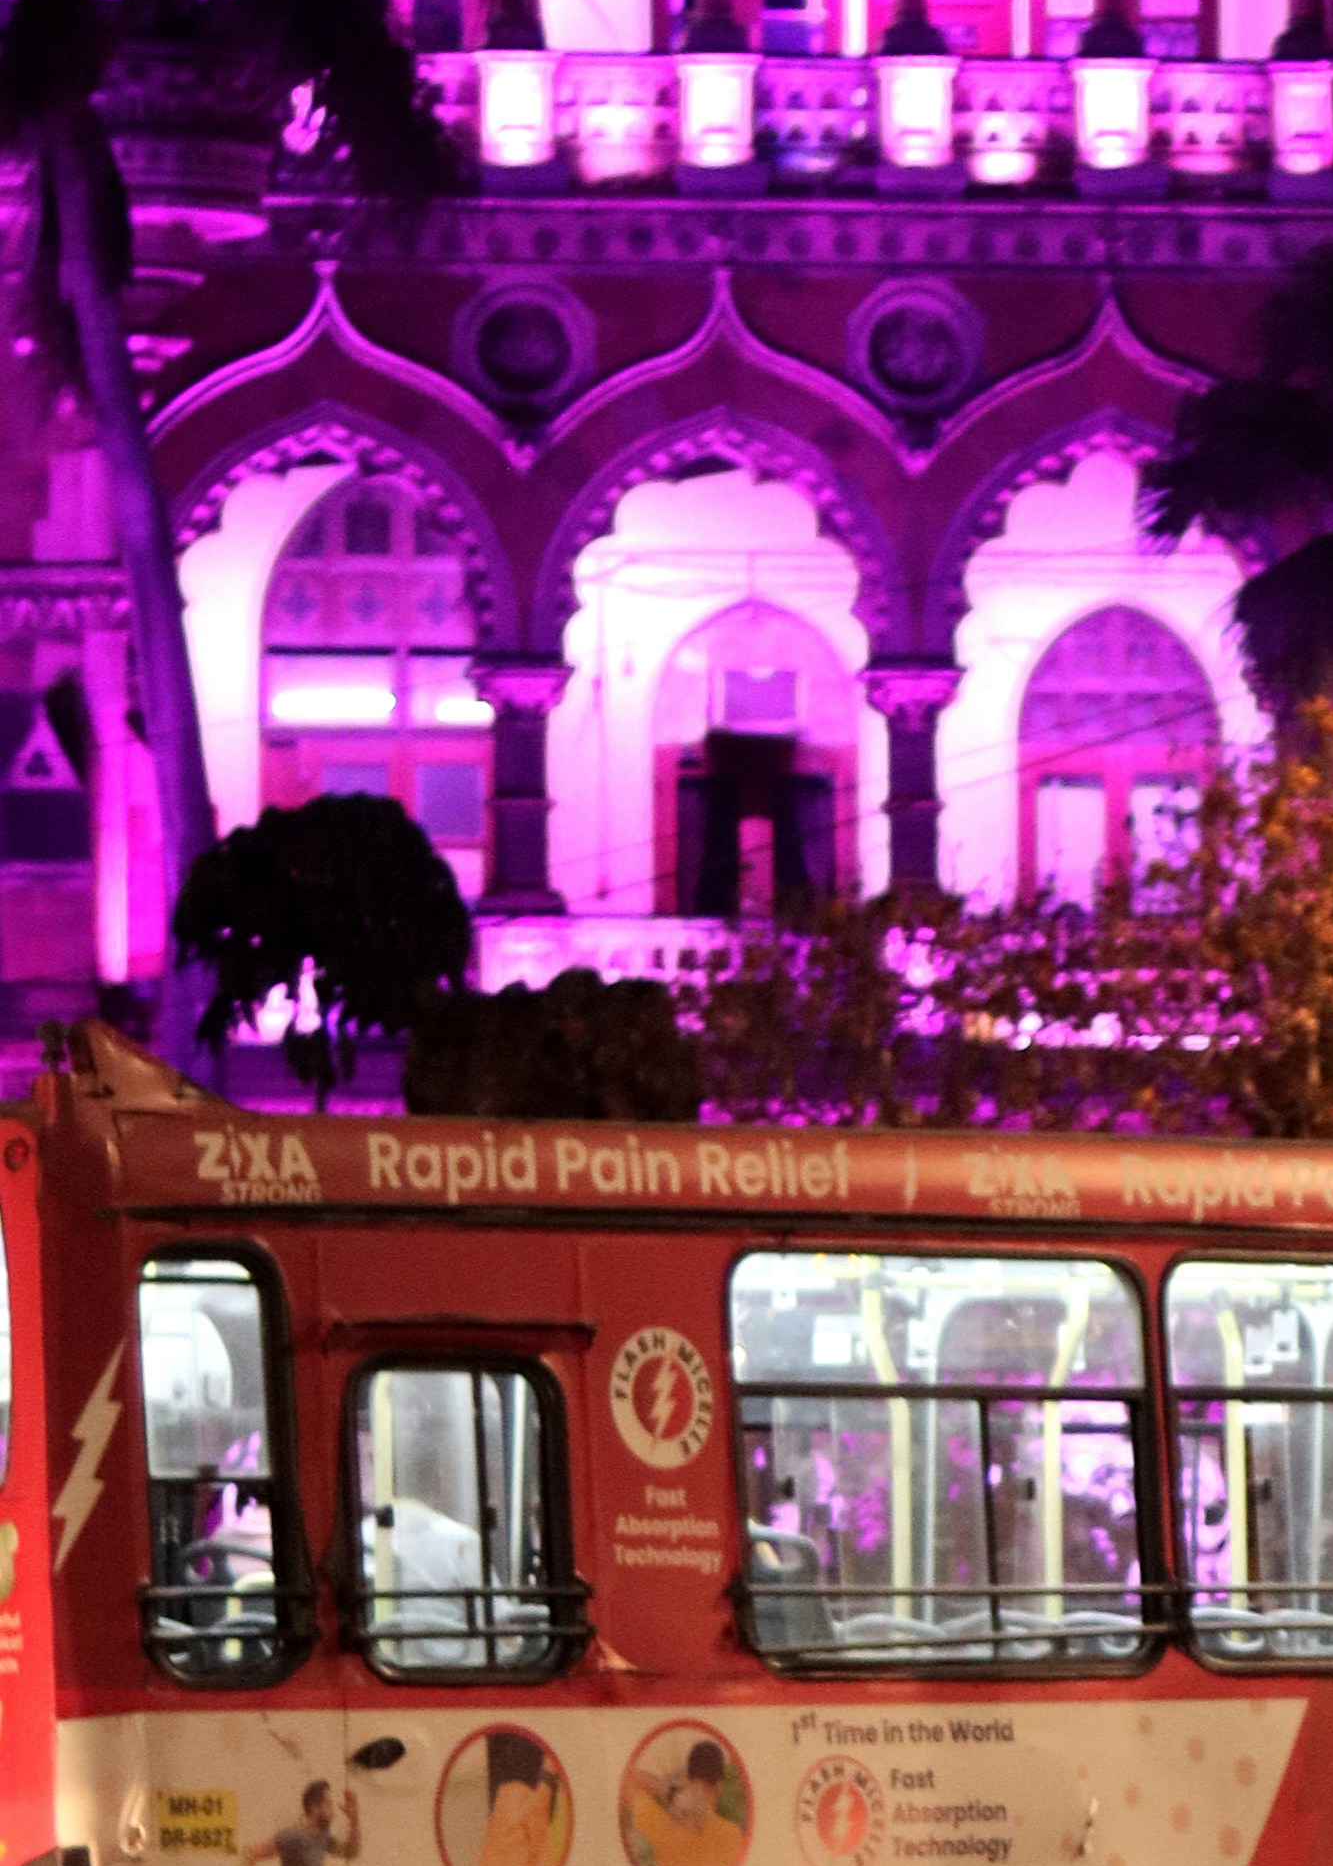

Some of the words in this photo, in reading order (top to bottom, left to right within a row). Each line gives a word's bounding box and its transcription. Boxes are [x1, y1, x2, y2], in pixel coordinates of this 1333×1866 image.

[367, 1131, 538, 1205] Rapid
[556, 1134, 682, 1194] Pain
[698, 1138, 849, 1198] Relief
[221, 1182, 322, 1205] STRONG
[1119, 1152, 1274, 1223] Rapid
[613, 1332, 666, 1401] FLASH
[645, 1486, 687, 1508] Fast
[615, 1513, 721, 1543] Absorption
[613, 1541, 723, 1575] Technology
[823, 1720, 878, 1745] Time
[882, 1719, 904, 1744] in
[908, 1719, 944, 1744] the
[949, 1717, 1015, 1743] World
[889, 1767, 936, 1790] Fast
[892, 1798, 1008, 1829] Absorption
[892, 1833, 1013, 1864] Technology
